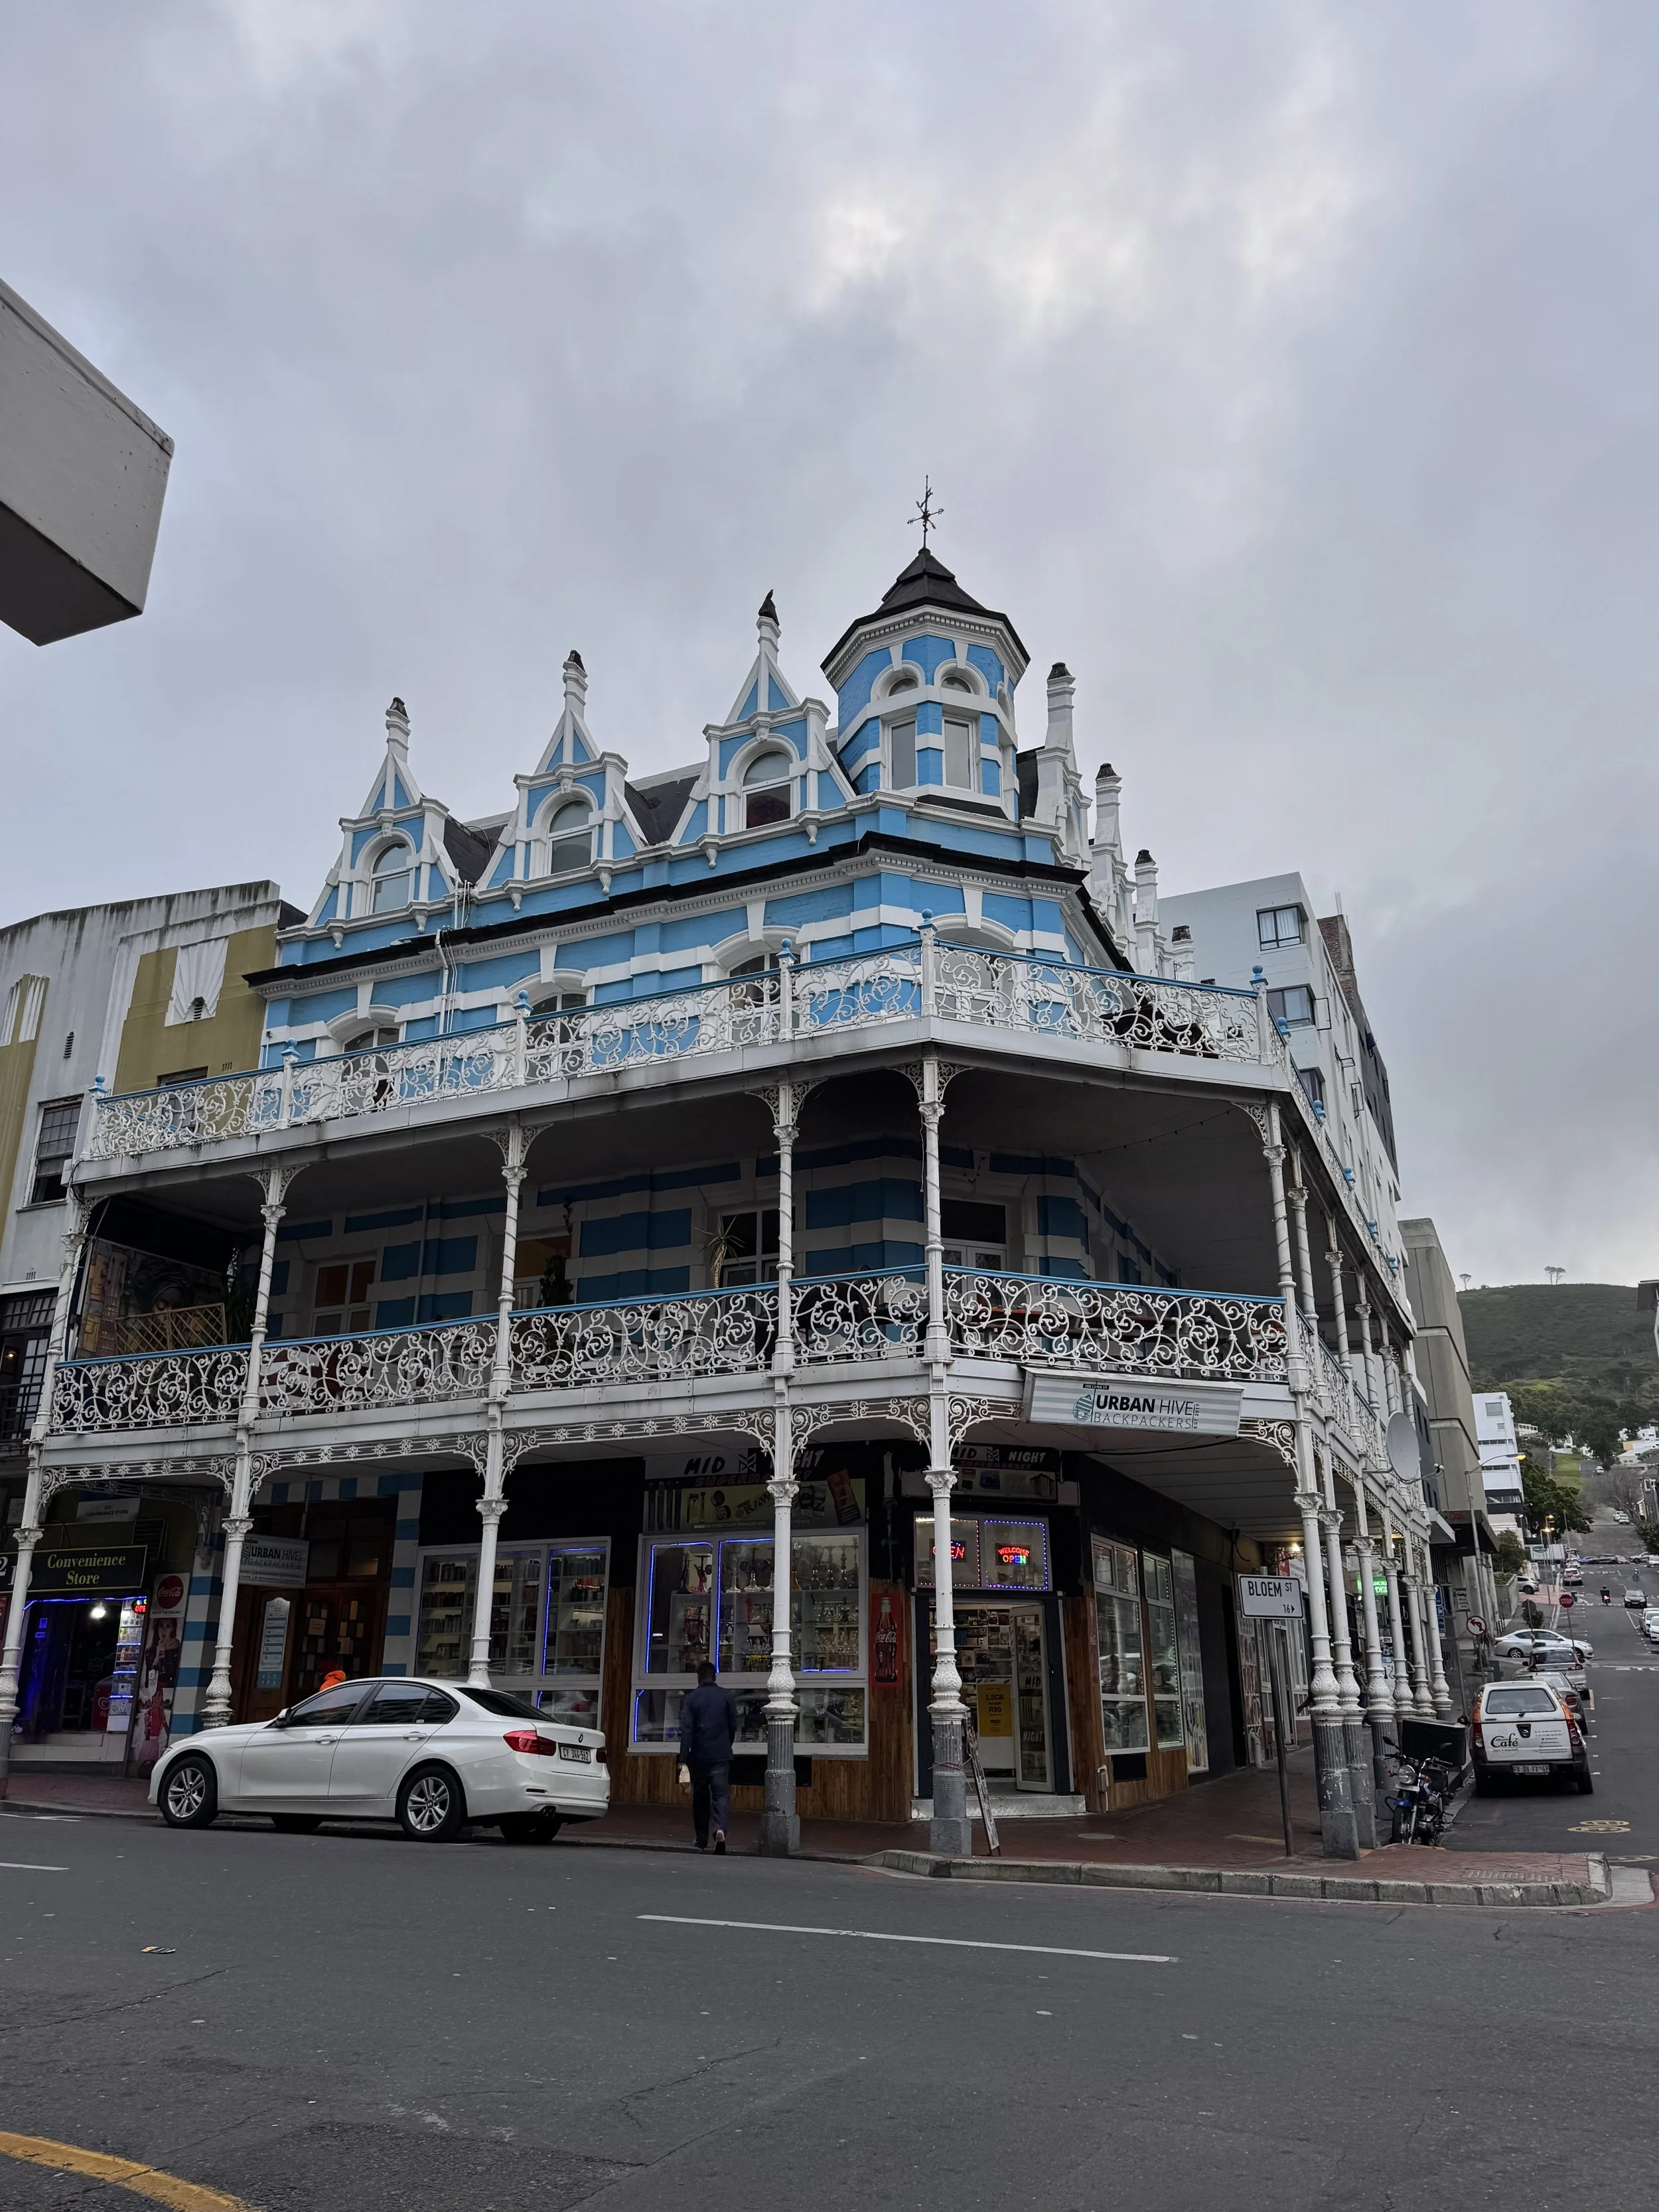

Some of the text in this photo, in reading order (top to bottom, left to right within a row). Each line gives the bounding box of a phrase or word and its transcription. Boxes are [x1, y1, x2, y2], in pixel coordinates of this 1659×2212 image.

[1096, 1394, 1194, 1416] URBAN HIVE
[1094, 1412, 1191, 1429] BACKPACKERS
[1009, 1450, 1046, 1463] NIGHT
[684, 1457, 725, 1475] MID
[251, 1546, 281, 1559] URBAN
[282, 1550, 299, 1561] HIVE
[998, 1546, 1030, 1557] WELCOME
[47, 1552, 126, 1569] Convenience
[1003, 1555, 1027, 1564] OPEN
[66, 1570, 100, 1586] Store
[1248, 1581, 1293, 1597] BLOEM ST
[1283, 1603, 1290, 1613] 16
[1490, 1733, 1519, 1747] Café
